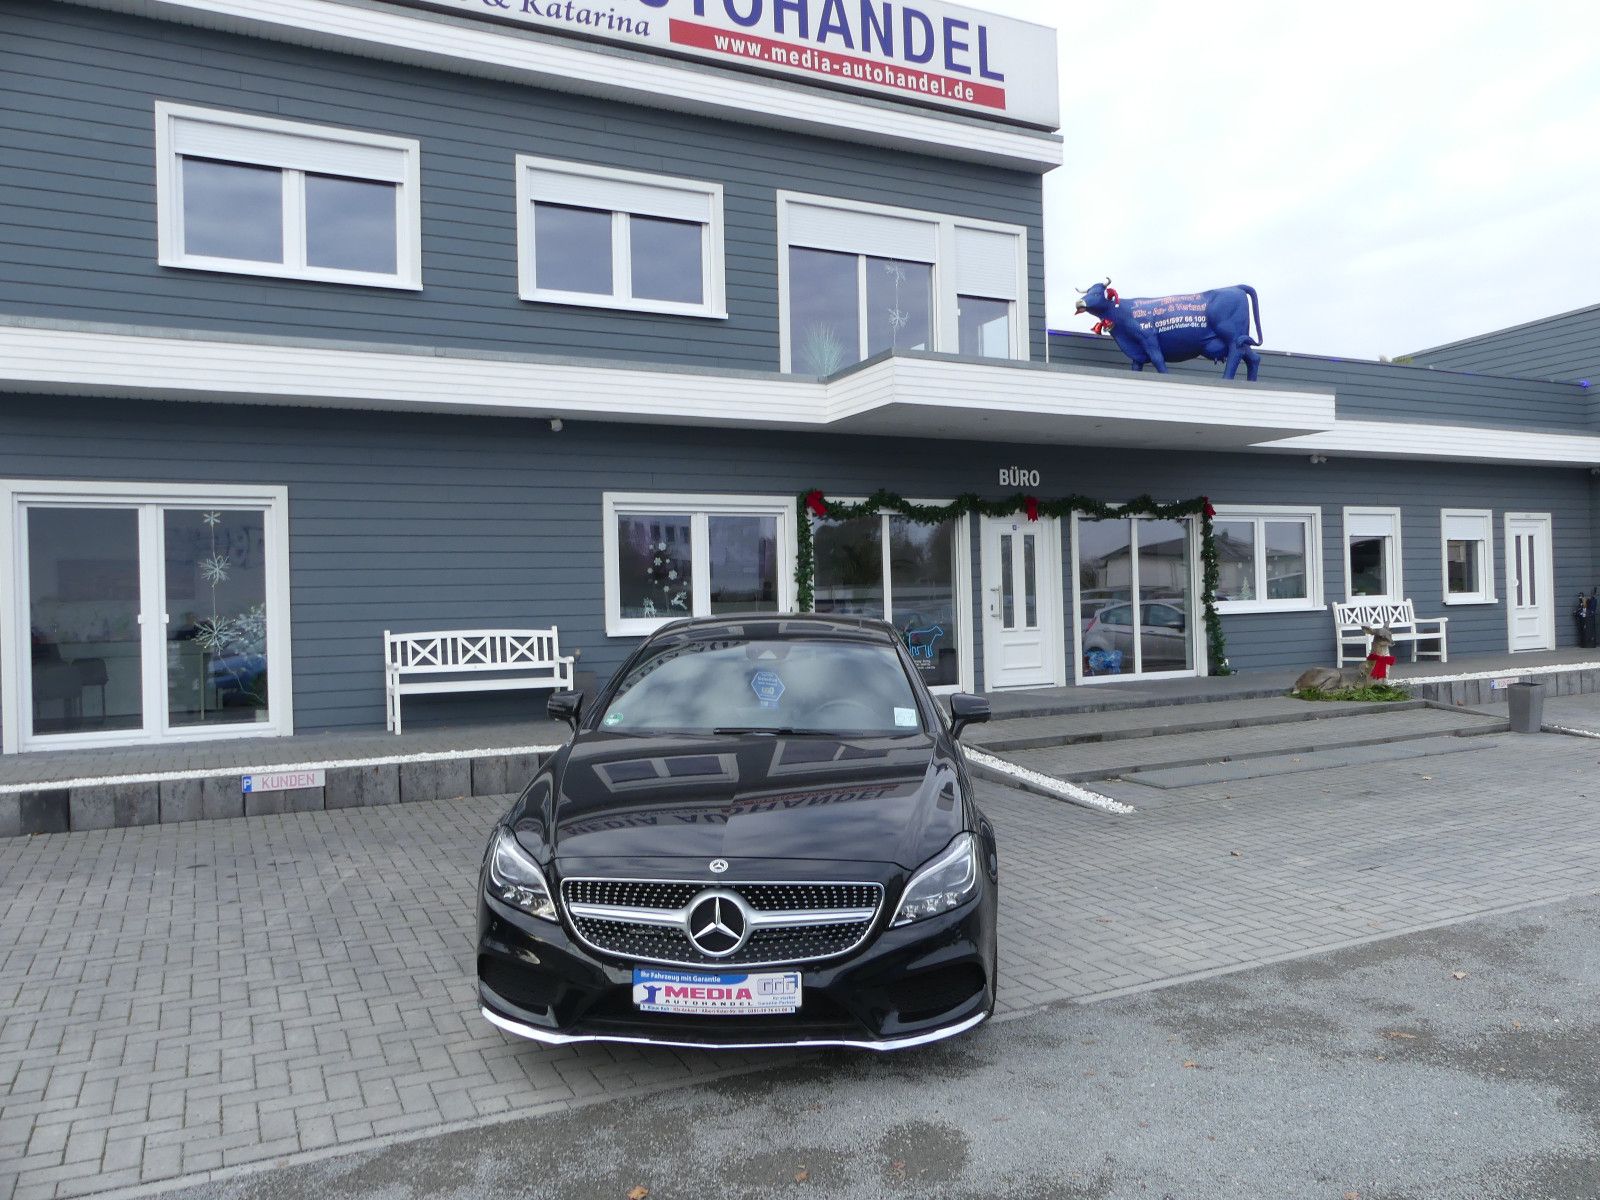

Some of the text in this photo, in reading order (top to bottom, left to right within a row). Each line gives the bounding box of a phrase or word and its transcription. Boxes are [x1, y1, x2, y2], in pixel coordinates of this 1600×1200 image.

[519, 0, 651, 37] Katarina
[714, 35, 976, 102] www.media-autohandel.de
[999, 466, 1040, 487] BÜRO
[262, 773, 315, 789] KUNDEN
[651, 972, 680, 982] Fahrzeug
[693, 975, 721, 983] Garantie
[665, 985, 753, 1000] MEDIA
